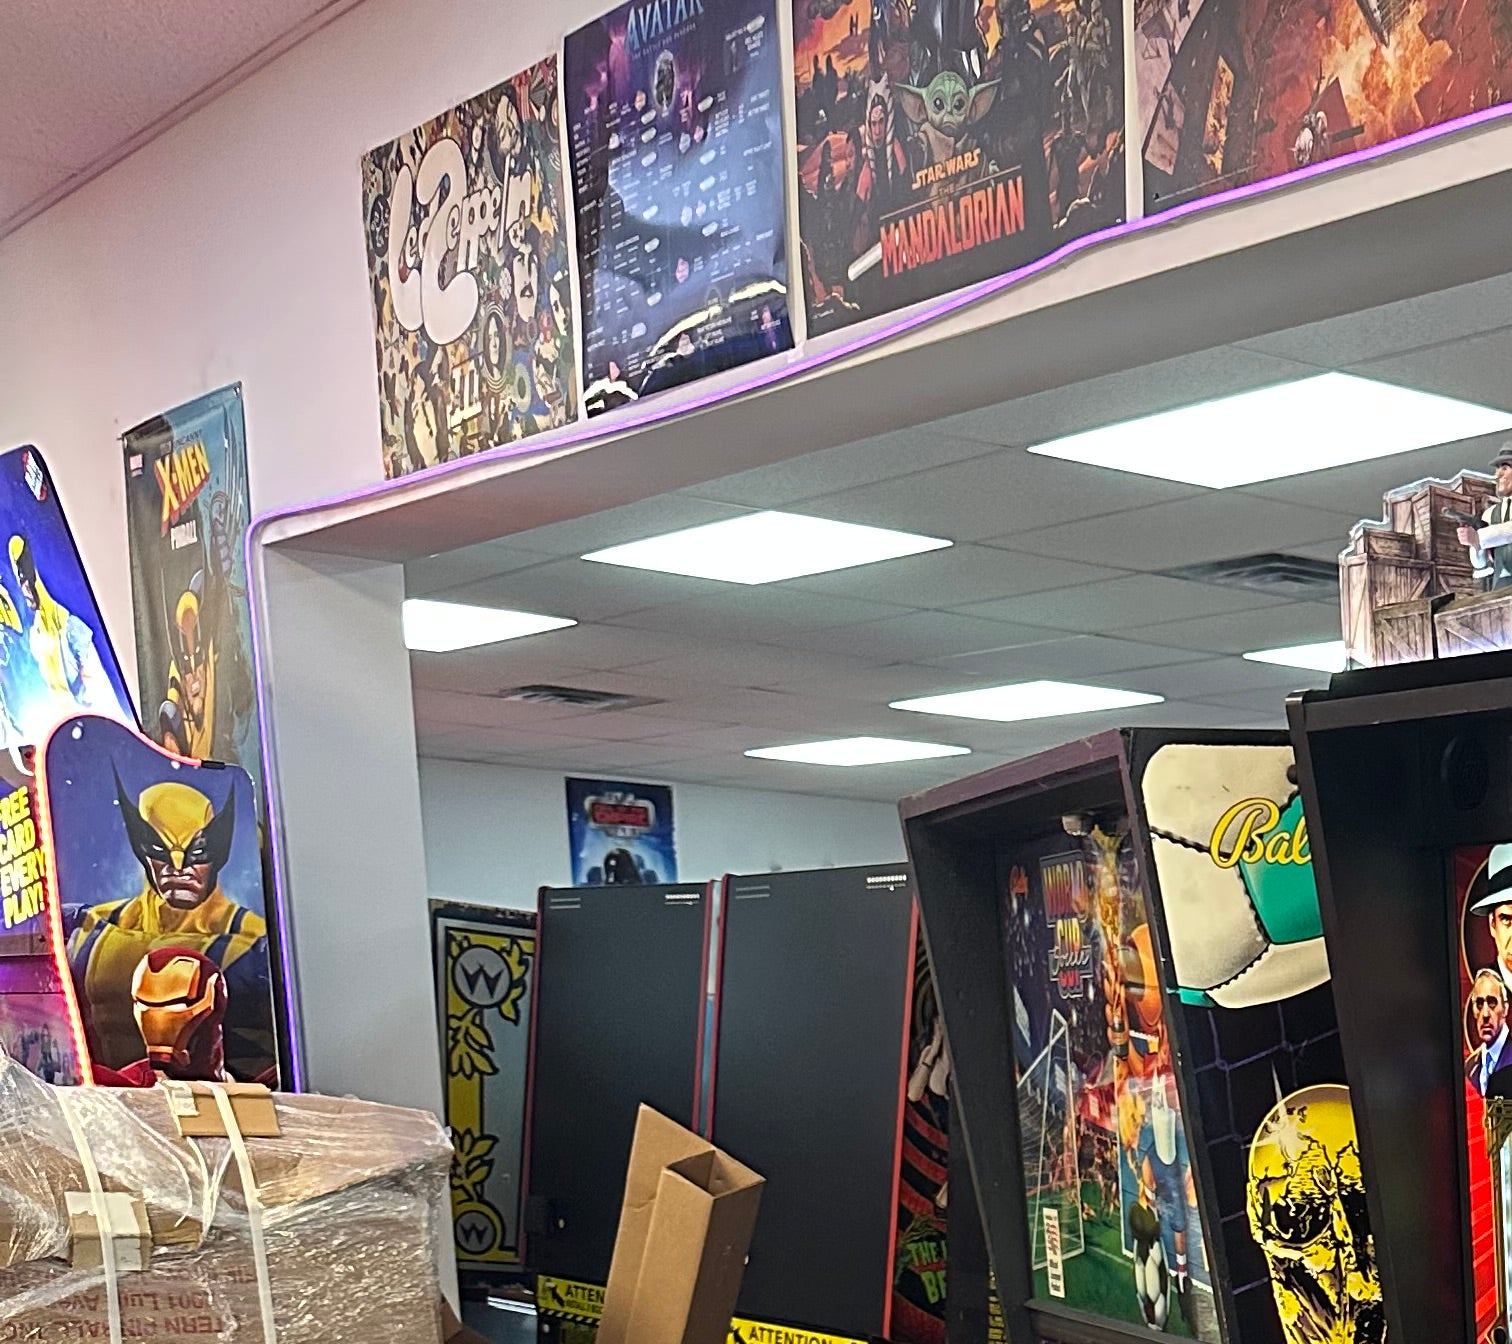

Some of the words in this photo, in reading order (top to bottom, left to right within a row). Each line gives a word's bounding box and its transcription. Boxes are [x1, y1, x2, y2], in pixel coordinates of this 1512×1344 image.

[912, 161, 946, 190] STAR
[946, 147, 982, 176] WARS
[880, 176, 1025, 278] MANDALORIAN
[154, 441, 211, 530] X-MEN
[0, 786, 31, 830] REE
[0, 847, 47, 898] EVERY
[3, 881, 46, 929] PLAY!
[565, 1284, 605, 1303] ATTEN
